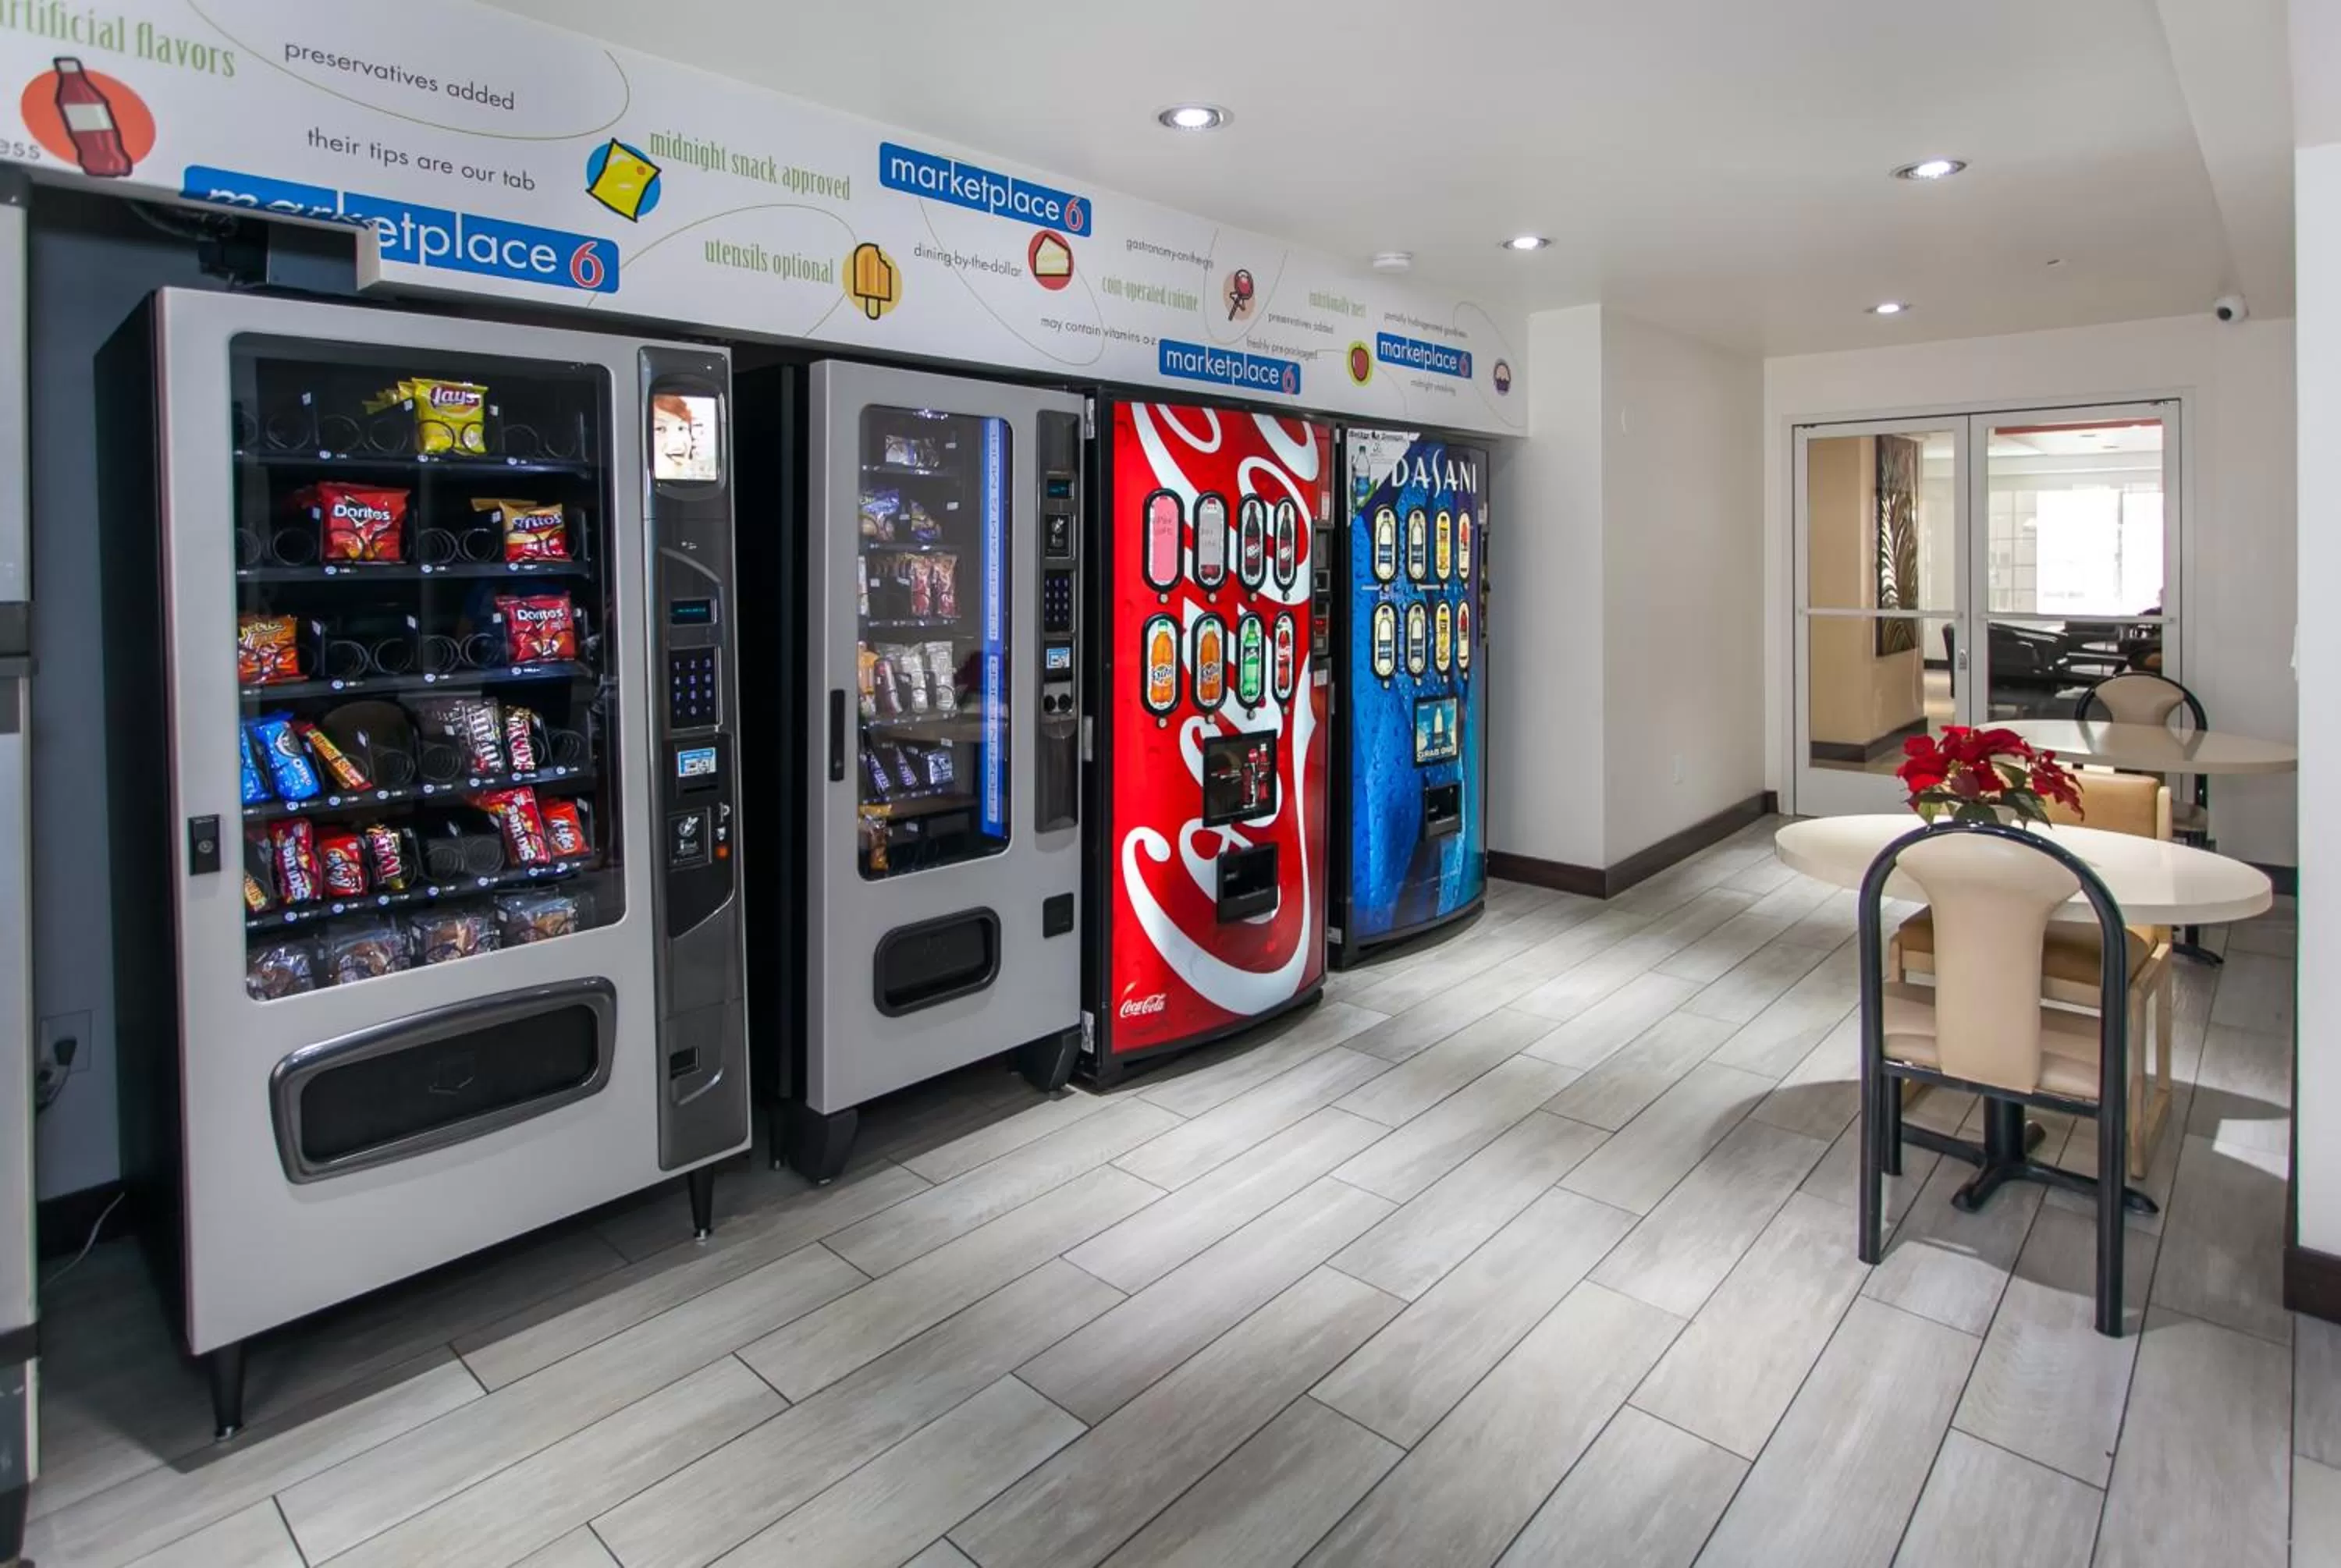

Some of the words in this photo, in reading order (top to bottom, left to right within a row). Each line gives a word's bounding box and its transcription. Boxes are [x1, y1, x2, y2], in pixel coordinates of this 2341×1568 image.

[0, 0, 125, 52] rtificial
[137, 21, 236, 78] flavors
[285, 43, 438, 92] preservatives
[446, 82, 515, 111] added
[307, 127, 361, 155] their
[370, 143, 409, 167] tips
[417, 156, 453, 174] are
[461, 165, 496, 183] our
[503, 170, 535, 191] tab
[649, 129, 727, 172] midnight
[731, 152, 777, 184] snack
[782, 165, 851, 200] approved
[890, 160, 1060, 221] marketplace
[1064, 197, 1084, 232] 6
[569, 240, 605, 289] 6
[705, 238, 768, 272] utensils
[773, 252, 834, 285] optional
[1040, 318, 1063, 332] may
[1065, 320, 1101, 337] contain
[1103, 328, 1140, 343] vitamins
[1380, 338, 1458, 371] marketplace
[1166, 345, 1280, 386] marketplace
[1391, 449, 1477, 499] DASANI
[333, 503, 391, 521] Doritos
[517, 608, 564, 623] Doritos
